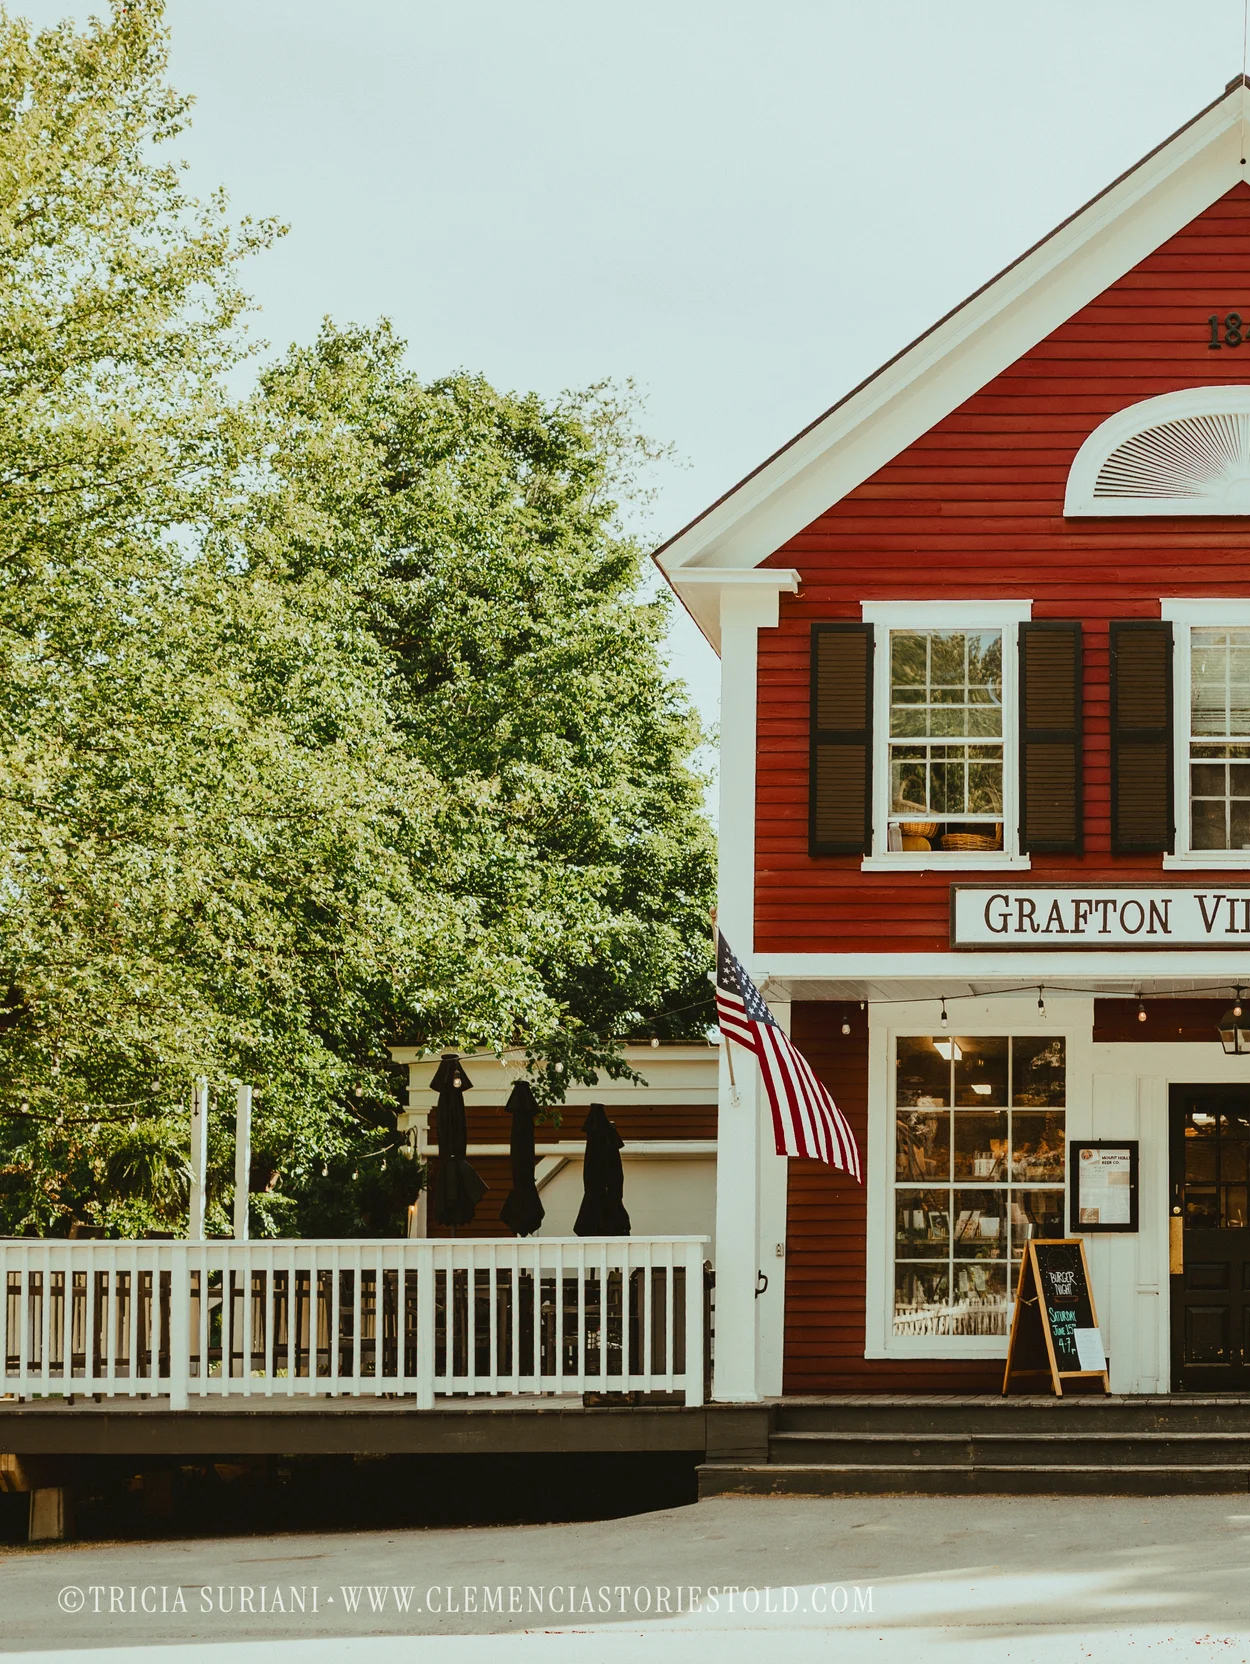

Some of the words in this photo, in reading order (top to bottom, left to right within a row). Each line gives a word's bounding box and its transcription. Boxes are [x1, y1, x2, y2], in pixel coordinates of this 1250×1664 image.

[984, 894, 1172, 934] GRAFTON
[1048, 1271, 1077, 1285] BURGER
[1054, 1283, 1073, 1295] NIGHT
